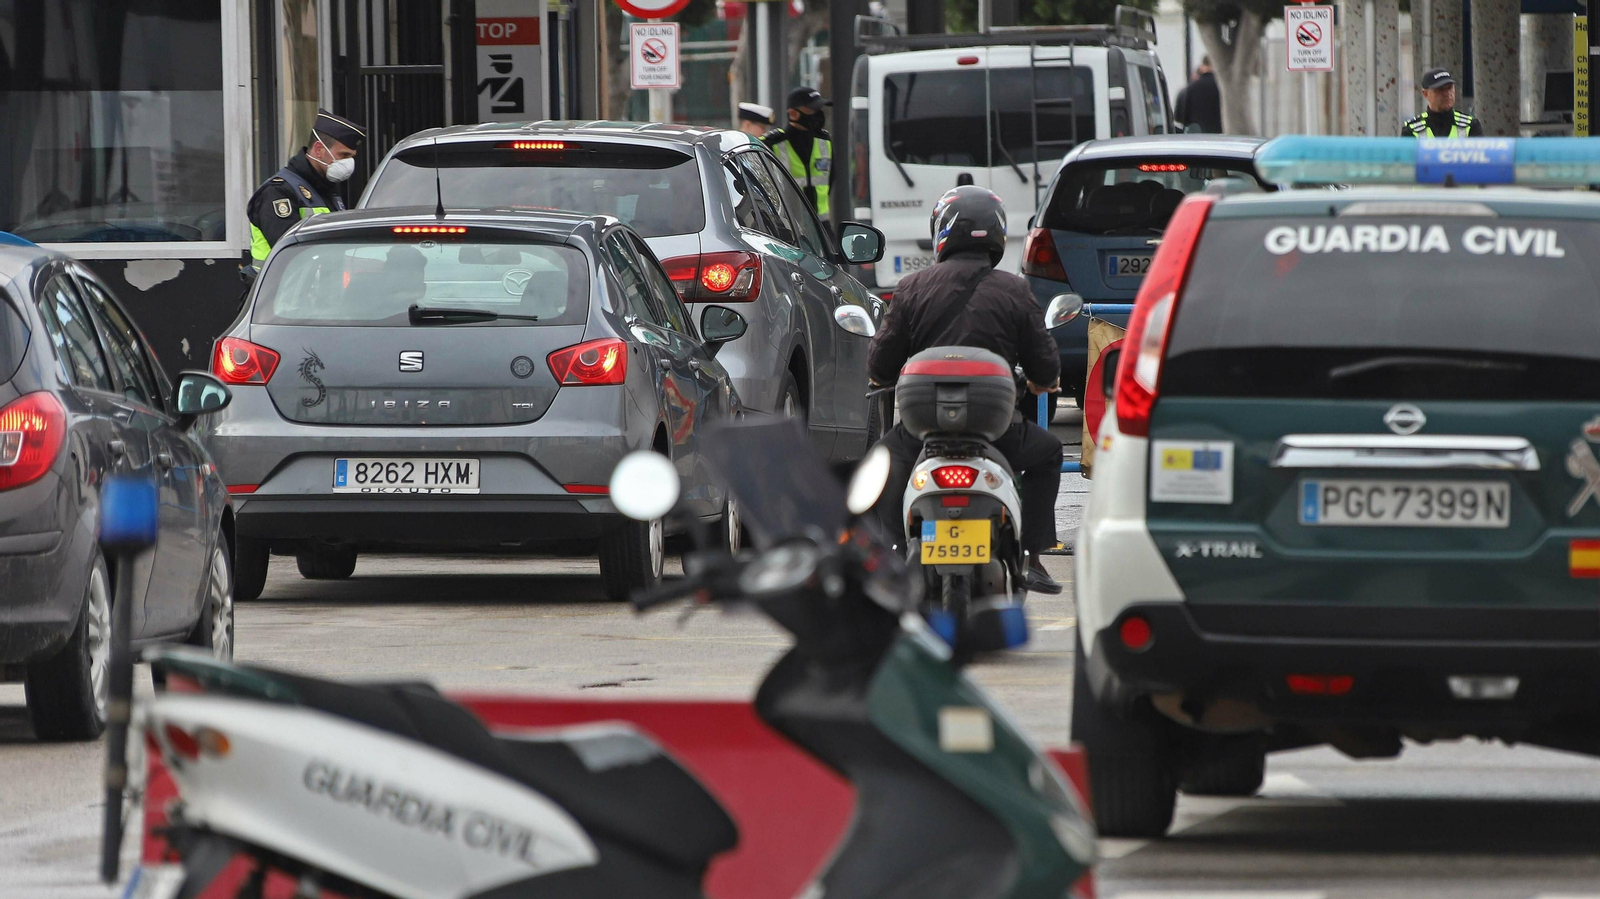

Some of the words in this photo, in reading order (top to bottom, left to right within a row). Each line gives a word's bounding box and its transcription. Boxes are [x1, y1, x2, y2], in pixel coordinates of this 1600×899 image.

[1290, 11, 1301, 19] NO
[1303, 11, 1328, 19] IDLING
[635, 28, 645, 36] NO
[647, 27, 673, 36] IDLING
[1438, 149, 1490, 164] CIVIL
[880, 200, 922, 208] RENAULT
[1264, 224, 1450, 255] GUARDIA
[1462, 225, 1565, 258] CIVIL
[371, 400, 451, 409] IBIZA
[355, 461, 415, 484] 8262
[424, 462, 470, 485] HXM
[1322, 486, 1505, 520] PGC7399N
[925, 545, 971, 557] 7593
[1175, 541, 1263, 559] X-TRAIL
[303, 758, 456, 837] GUARDIA
[462, 808, 542, 869] CIVIL
